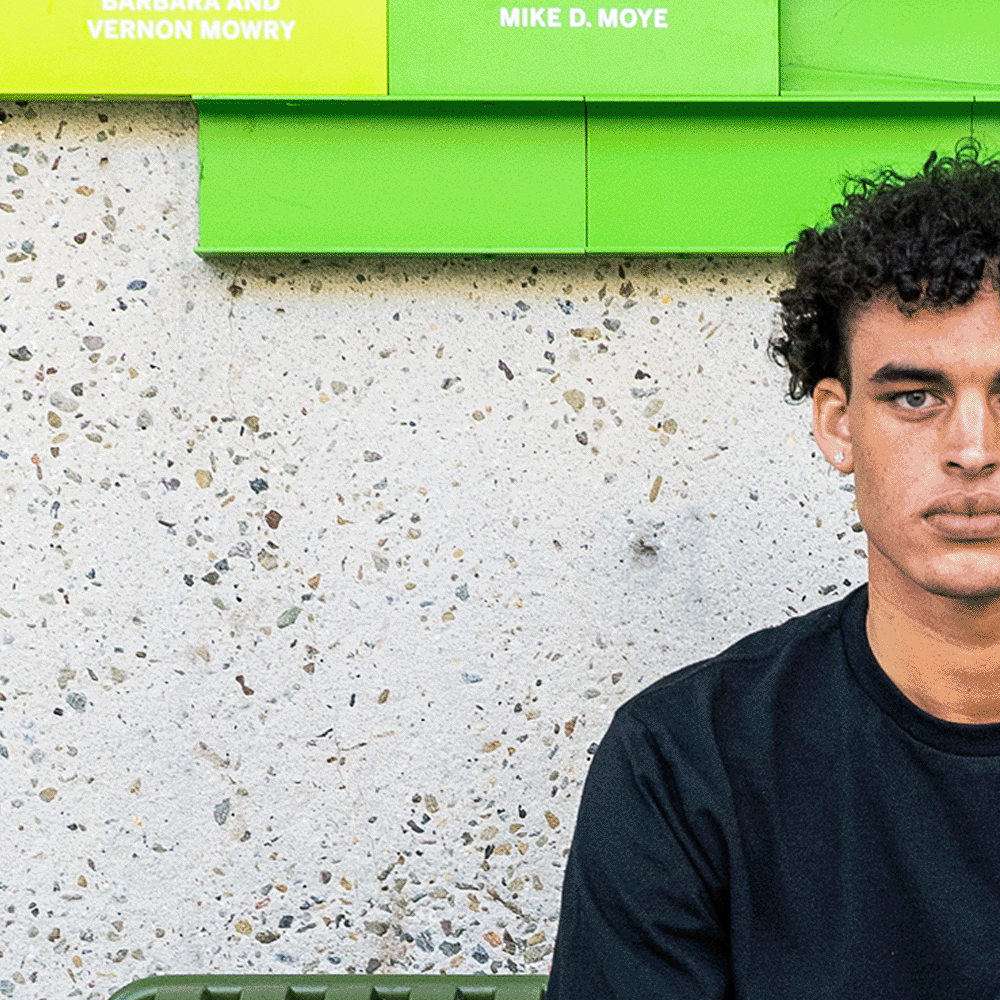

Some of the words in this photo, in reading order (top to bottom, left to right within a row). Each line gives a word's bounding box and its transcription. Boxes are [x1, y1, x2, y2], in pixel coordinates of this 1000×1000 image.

[499, 7, 562, 28] MIKE
[569, 7, 592, 28] D.
[598, 7, 669, 29] MOYE
[86, 19, 193, 40] VERNON
[200, 19, 296, 40] MOWRY
